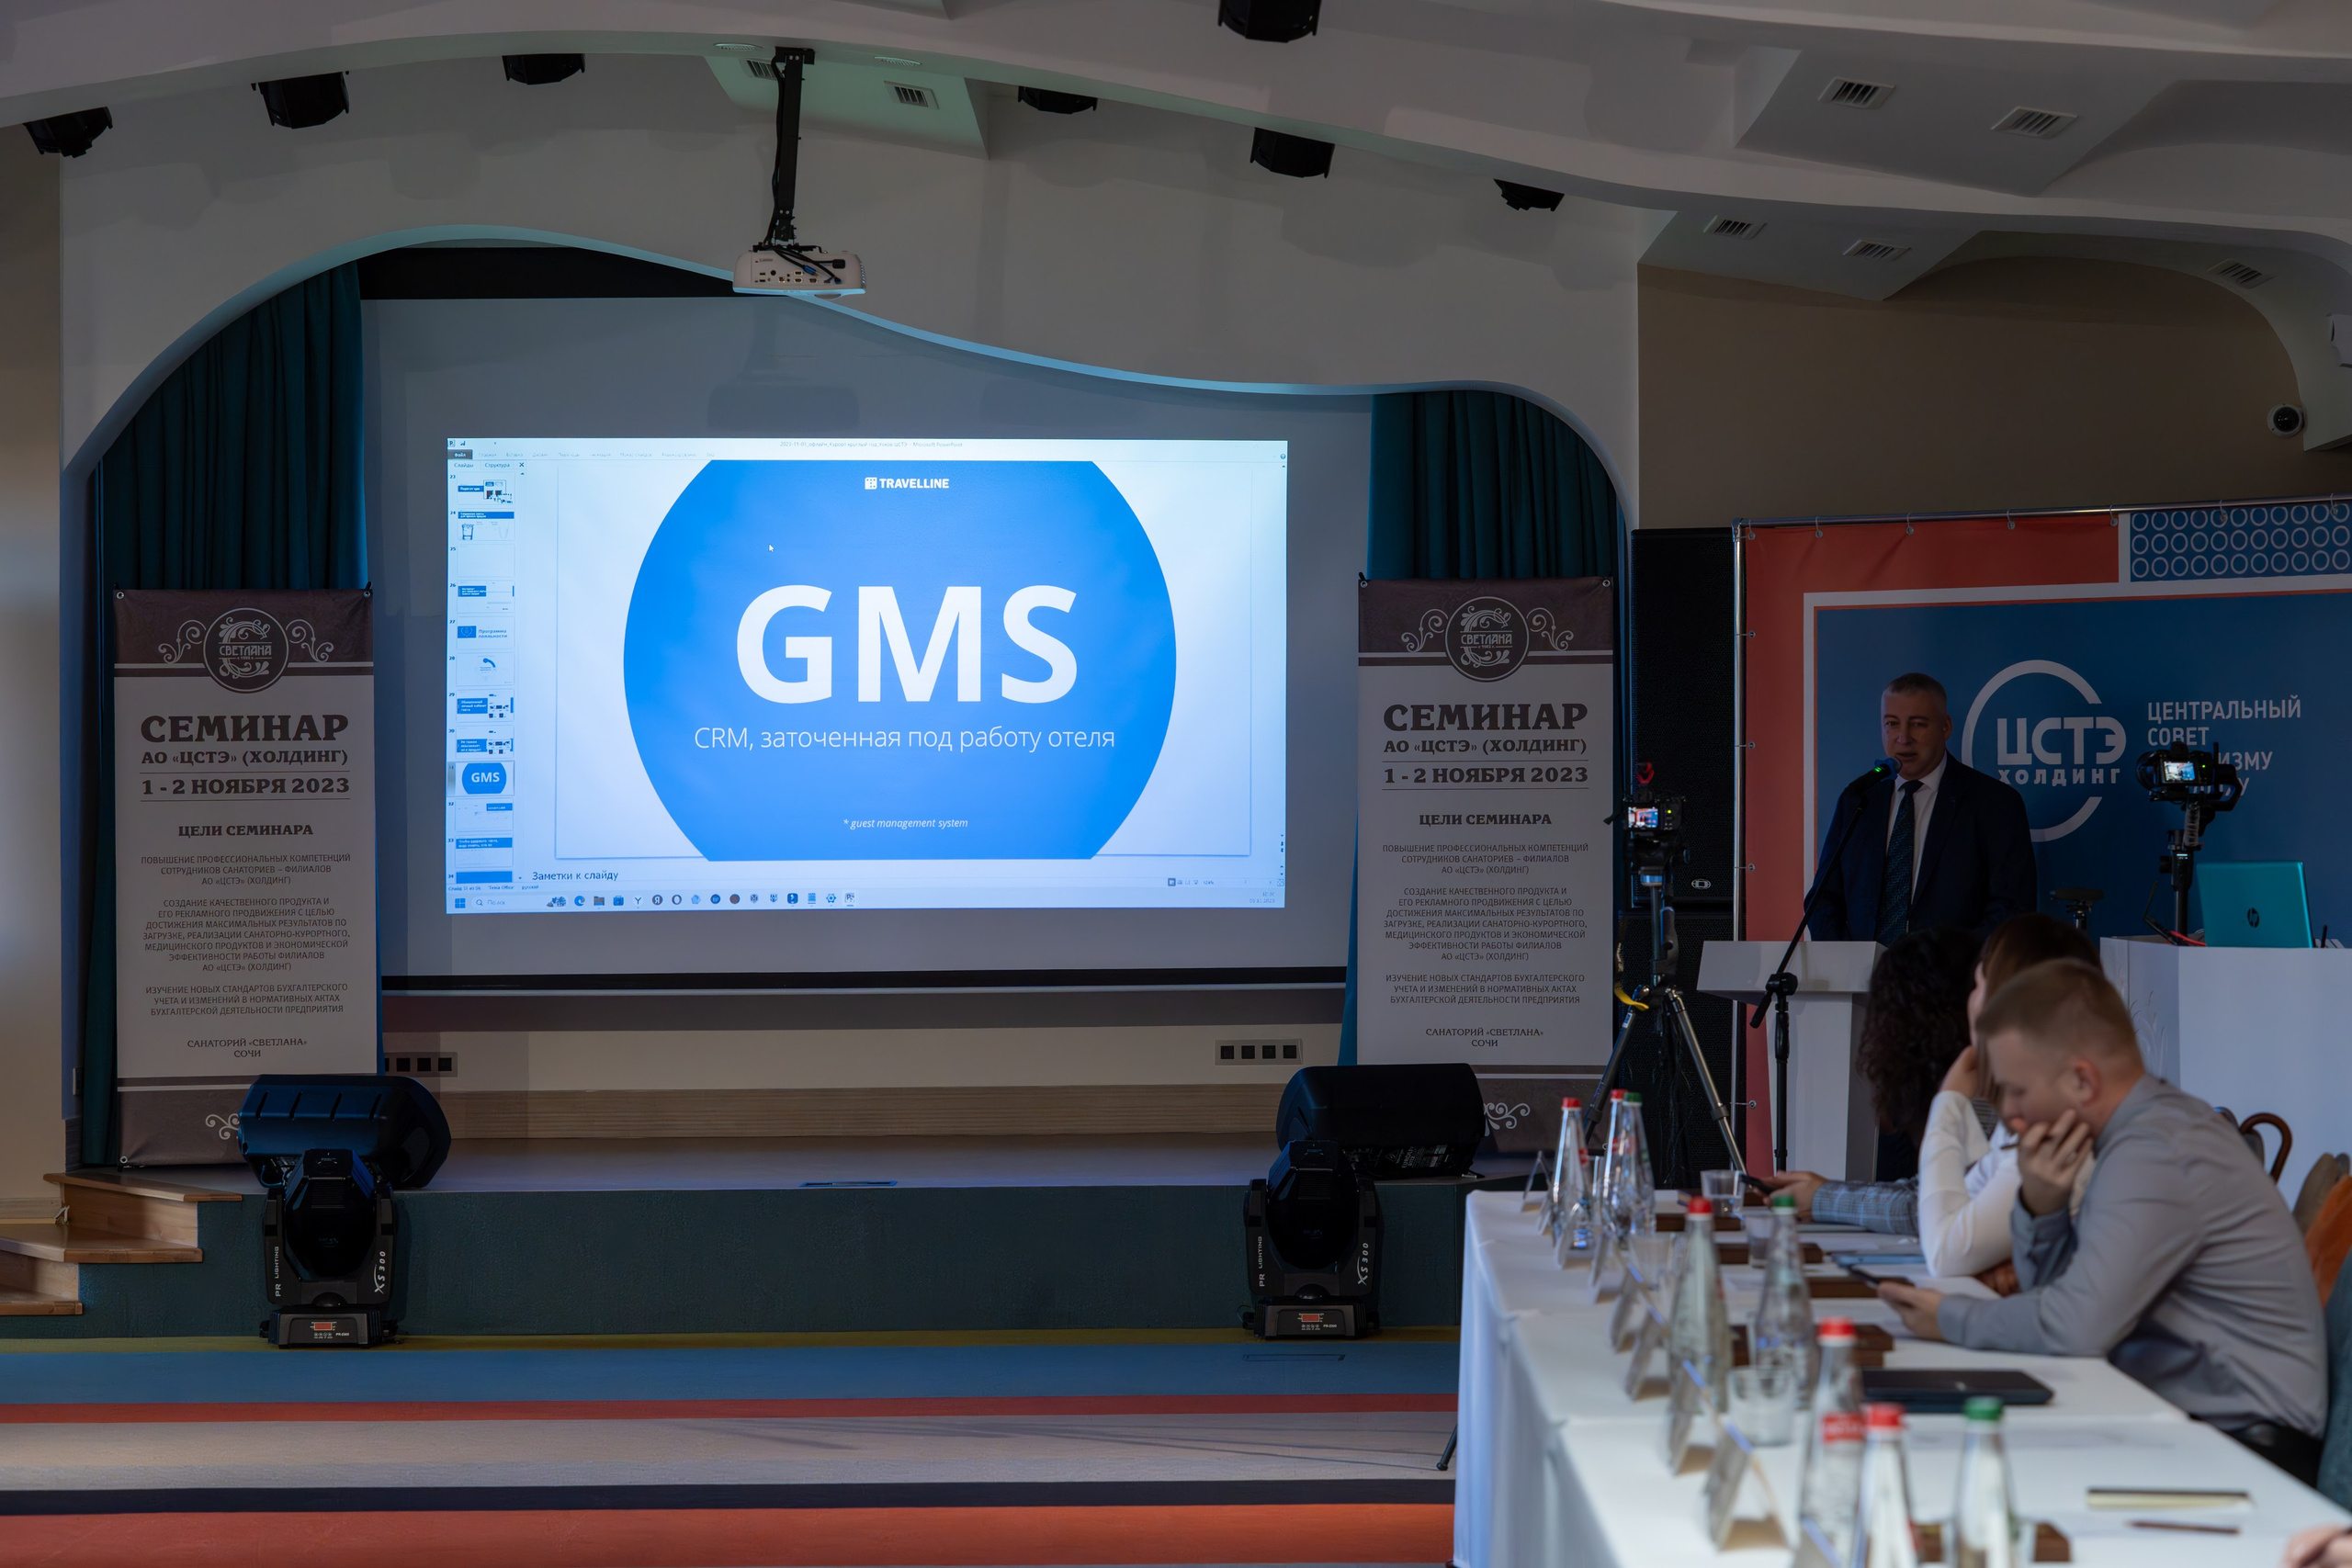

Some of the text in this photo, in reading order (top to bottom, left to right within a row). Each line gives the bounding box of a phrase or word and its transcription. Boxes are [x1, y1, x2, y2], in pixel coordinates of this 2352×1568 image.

[484, 462, 511, 470] Структура
[879, 478, 949, 489] TRAVELLINE
[737, 584, 1078, 704] GMS
[1461, 634, 1512, 645] СВЕТЛАНА
[219, 645, 272, 656] СВЕТЛАНА
[2148, 694, 2301, 724] ЦЕНТРАЛЬНЫЙ
[1384, 703, 1588, 731] СЕМИНАР
[141, 715, 349, 742] СЕМИНАР
[695, 726, 1114, 753] CRM, заточенная под работу отеля
[1996, 716, 2126, 765] ЦСТЭ
[2148, 727, 2210, 746] СОВЕТ
[1384, 739, 1587, 755] АО «ЦСТЭ» (ХОЛДИНГ)
[141, 750, 348, 766] АО «ЦСТЭ» (ХОЛДИНГ)
[470, 772, 501, 784] GMS
[1385, 769, 1395, 784] 1
[1414, 769, 1426, 783] 2
[1432, 768, 1525, 783] НОЯБРЯ
[1531, 767, 1589, 782] 2023
[1998, 768, 2120, 786] ХОЛДИНГ
[142, 780, 153, 795] 1
[173, 780, 185, 794] 2
[191, 779, 286, 795] НОЯБРЯ
[292, 778, 349, 793] 2023
[851, 819, 968, 830] guest management system
[1419, 814, 1552, 827] ЦЕЛИ СЕМИНАРА
[178, 825, 313, 839] ЦЕЛИ СЕМИНАРА
[1528, 842, 1589, 853] КОМПЕТЕНЦИЙ
[141, 853, 351, 864] ПОВЫШЕНИЕ ПРОФЕССИОНАЛЬНЫХ КОМПЕТЕНЦИЙ
[1401, 855, 1461, 863] СОТРУДНИКОВ
[1523, 854, 1569, 863] ФИЛИАЛОВ
[161, 866, 220, 875] СОТРУДНИКОВ
[222, 865, 276, 874] САНАТОРИЕВ
[285, 864, 332, 873] ФИЛИАЛОВ
[1455, 866, 1484, 874] «ЦСТЭ»
[1486, 865, 1529, 874] (ХОЛДИНГ)
[201, 876, 291, 886] АО «ЦСТЭ» (ХОЛДИНГ)
[532, 871, 572, 880] Заметки
[584, 870, 619, 883] слайду
[1404, 888, 1447, 897] СОЗДАНИЕ
[1449, 887, 1516, 896] КАЧЕСТВЕННОГО
[1518, 887, 1560, 897] ПРОДУКТА
[164, 899, 207, 908] СОЗДАНИЕ
[209, 898, 277, 907] КАЧЕСТВЕННОГО
[279, 897, 322, 907] ПРОДУКТА
[1472, 898, 1534, 908] ПРОДВИЖЕНИЯ
[1543, 898, 1572, 908] ЦЕЛЬЮ
[175, 909, 231, 918] РЕКЛАМНОГО
[232, 908, 296, 918] ПРОДВИЖЕНИЯ
[305, 908, 334, 917] ЦЕЛЬЮ
[1386, 909, 1442, 918] ДОСТИЖЕНИЯ
[1517, 908, 1570, 917] РЕЗУЛЬТАТОВ
[1572, 908, 1584, 917] ПО
[146, 919, 346, 930] ДОСТИЖЕНИЯ МАКСИМАЛЬНЫХ РЕЗУЛЬТАТОВ ПО
[1384, 919, 1588, 929] ЗАГРУЗКЕ, РЕАЛИЗАЦИИ САНАТОРНО-КУРОРТНОГО,
[142, 930, 350, 942] ЗАГРУЗКЕ, РЕАЛИЗАЦИИ САНАТОРНО-КУРОРТНОГО,
[1385, 931, 1452, 940] МЕДИЦИНСКОГО
[1454, 931, 1502, 940] ПРОДУКТОВ
[1511, 929, 1586, 939] ЭКОНОМИЧЕСКОЙ
[145, 942, 213, 952] МЕДИЦИНСКОГО
[215, 942, 264, 950] ПРОДУКТОВ
[274, 939, 348, 949] ЭКОНОМИЧЕСКОЙ
[1408, 942, 1479, 950] ЭФФЕКТИВНОСТИ
[169, 951, 324, 961] ЭФФЕКТИВНОСТИ РАБОТЫ ФИЛИАЛОВ
[1455, 953, 1484, 962] «ЦСТЭ»
[1486, 952, 1529, 962] (ХОЛДИНГ)
[202, 963, 291, 973] АО «ЦСТЭ» (ХОЛДИНГ)
[1461, 975, 1512, 983] СТАНДАРТОВ
[1514, 974, 1585, 982] БУХГАЛТЕРСКОГО
[146, 986, 188, 994] ИЗУЧЕНИЕ
[222, 985, 275, 994] СТАНДАРТОВ
[277, 984, 348, 992] БУХГАЛТЕРСКОГО
[1428, 984, 1478, 993] ИЗМЕНЕНИЙ
[1487, 985, 1550, 993] НОРМАТИВНЫХ
[188, 995, 241, 1004] ИЗМЕНЕНИЙ
[250, 995, 312, 1003] НОРМАТИВНЫХ
[314, 994, 340, 1002] АКТАХ
[1391, 995, 1580, 1005] БУХГАЛТЕРСКОЙ ДЕЯТЕЛЬНОСТИ ПРЕДПРИЯТИЯ
[151, 1005, 344, 1016] БУХГАЛТЕРСКОЙ ДЕЯТЕЛЬНОСТИ ПРЕДПРИЯТИЯ
[1426, 1027, 1484, 1036] САНАТОРИЙ
[187, 1038, 246, 1047] САНАТОРИЙ
[1357, 1256, 1368, 1286] XS
[374, 1264, 385, 1294] XS
[1259, 1273, 1265, 1287] PR
[275, 1283, 281, 1297] PR
